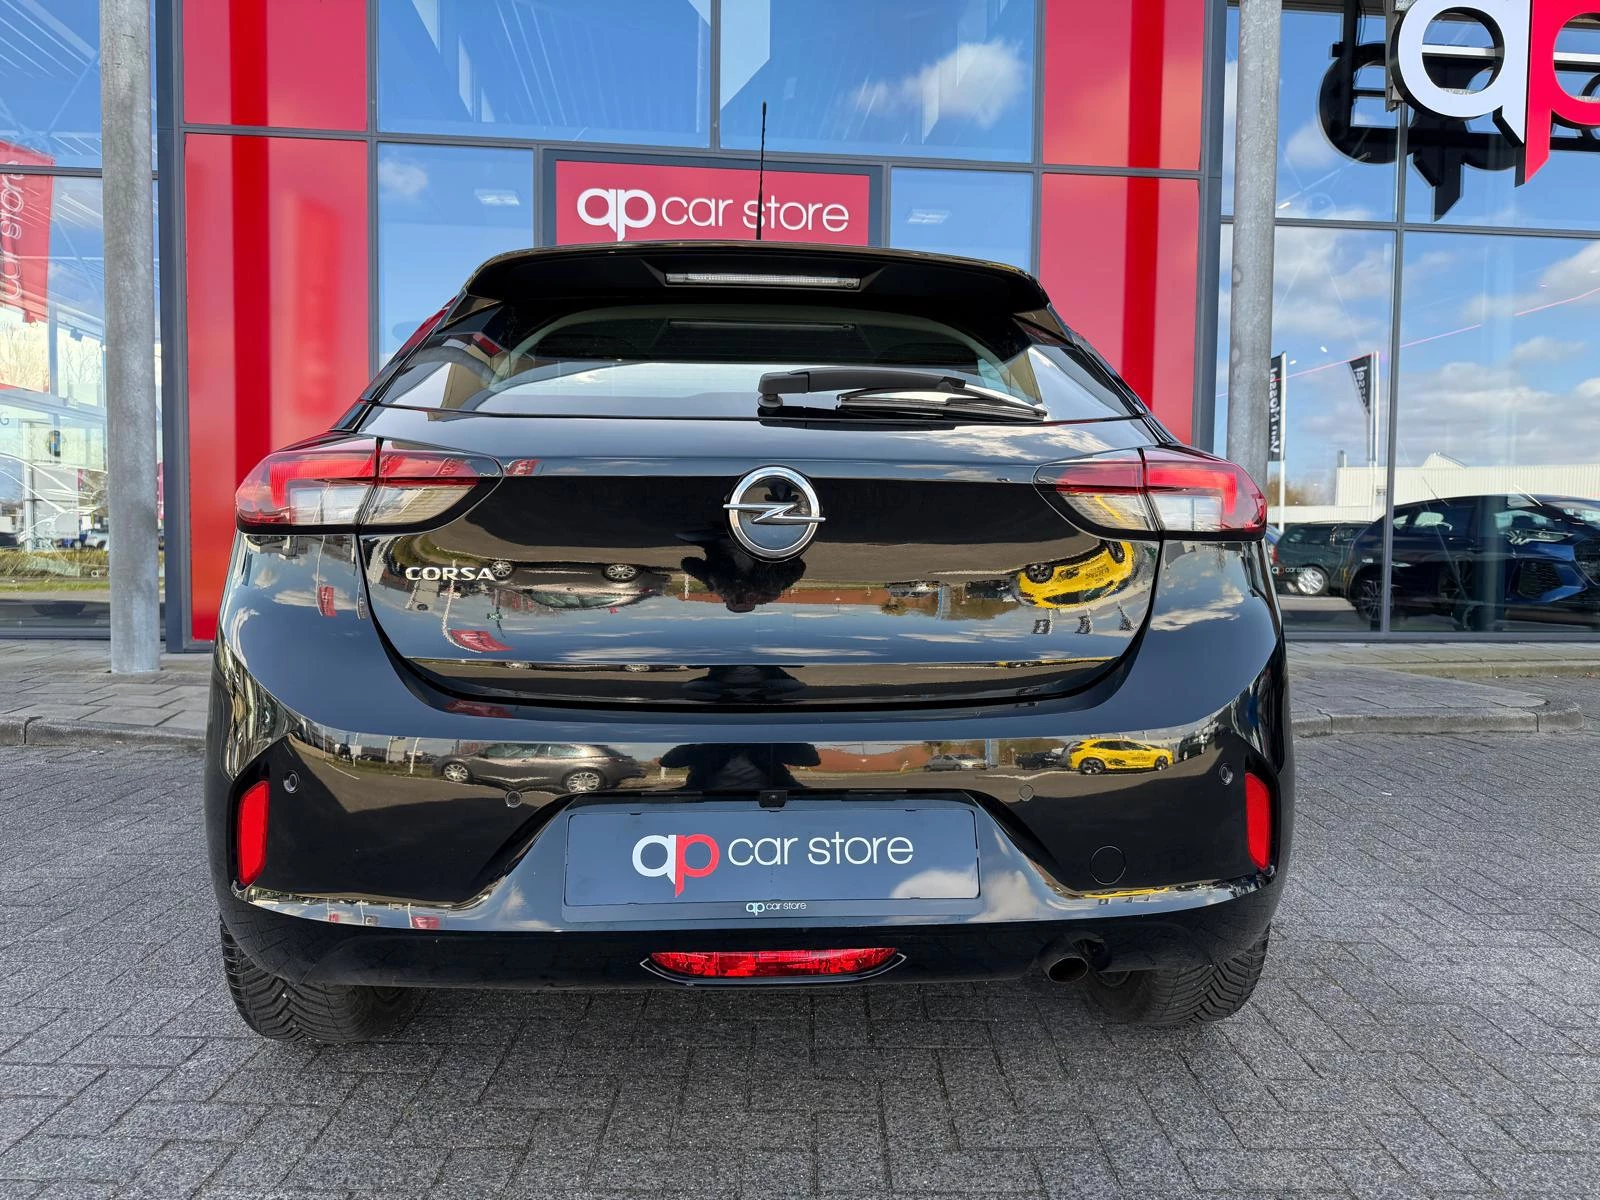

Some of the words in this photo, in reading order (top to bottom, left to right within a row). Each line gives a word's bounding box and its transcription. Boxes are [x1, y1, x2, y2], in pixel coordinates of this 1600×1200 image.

[577, 188, 656, 242] ap
[662, 196, 733, 227] car
[743, 195, 849, 232] store
[405, 566, 497, 581] CORSA
[632, 833, 720, 898] ap
[728, 838, 798, 866] car
[807, 831, 913, 865] store
[745, 902, 765, 916] ap
[766, 902, 781, 910] car
[782, 902, 807, 910] store
